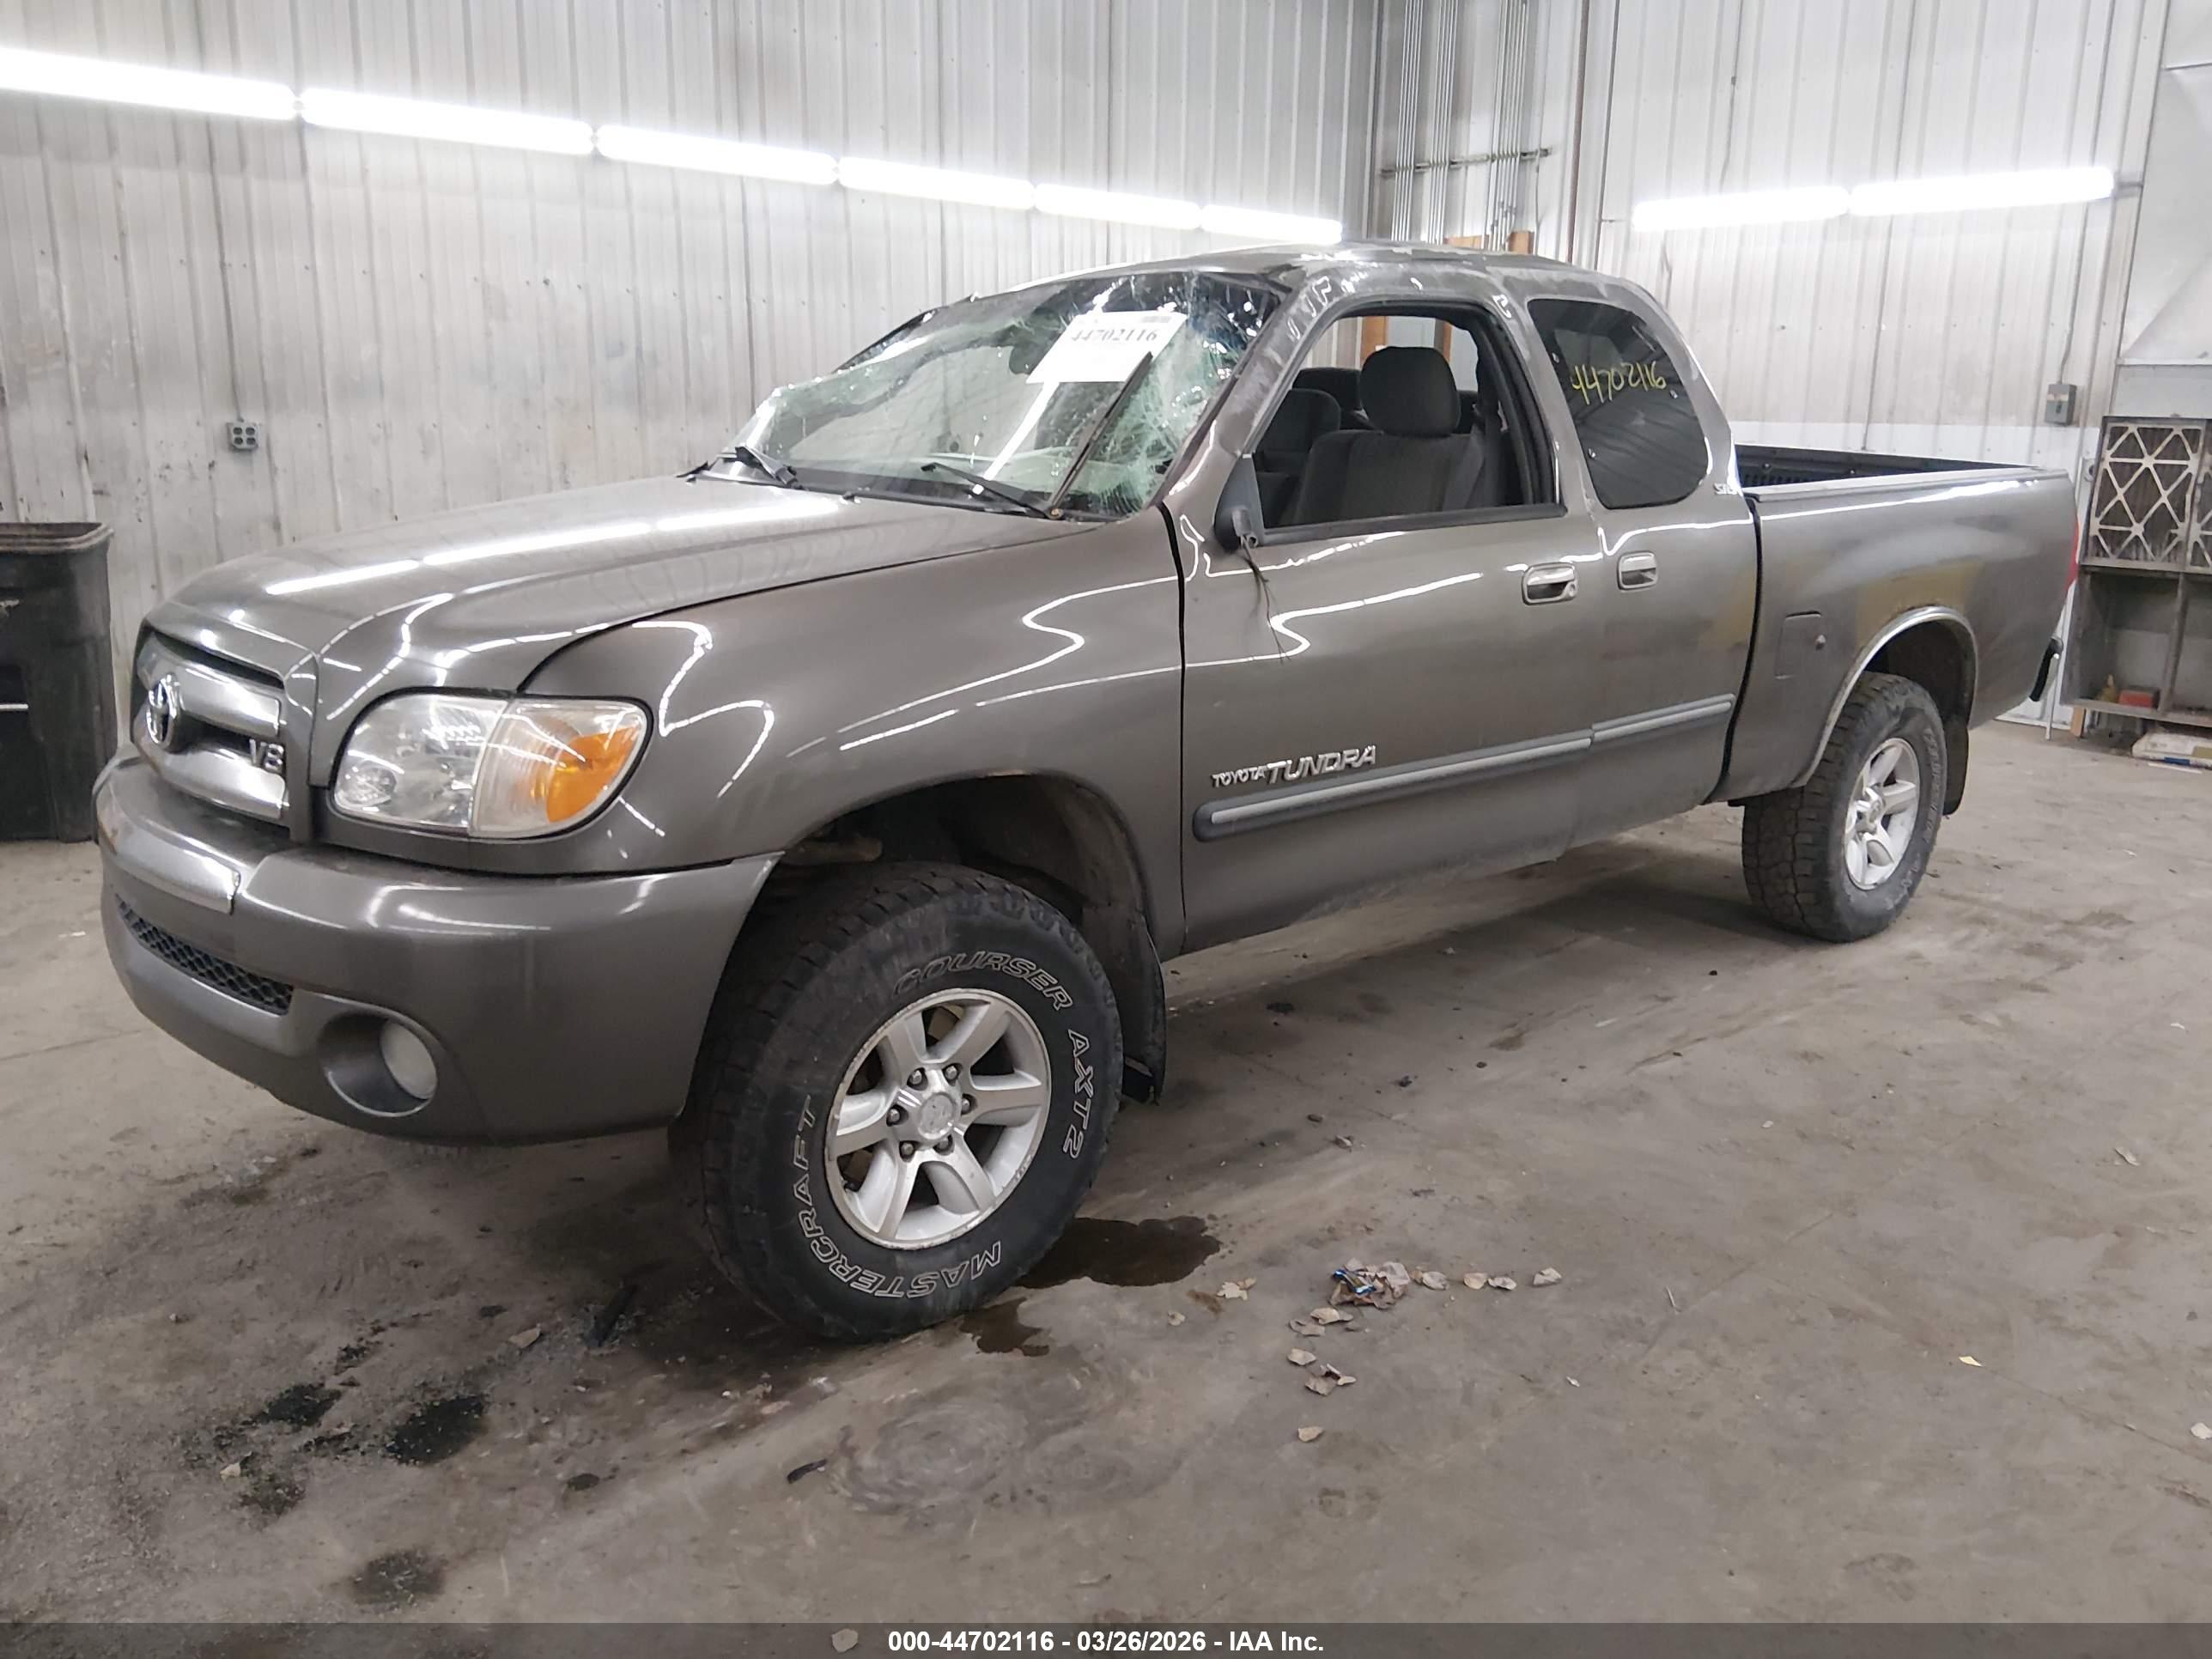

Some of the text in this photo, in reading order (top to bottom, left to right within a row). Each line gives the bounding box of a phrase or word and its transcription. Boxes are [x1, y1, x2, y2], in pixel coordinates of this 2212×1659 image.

[1571, 361, 1667, 405] 44702116
[1212, 744, 1376, 788] TOYOTA TUNDRA
[894, 950, 1096, 1159] COURSER AXT2
[793, 1094, 1002, 1299] MASTERCRAFT
